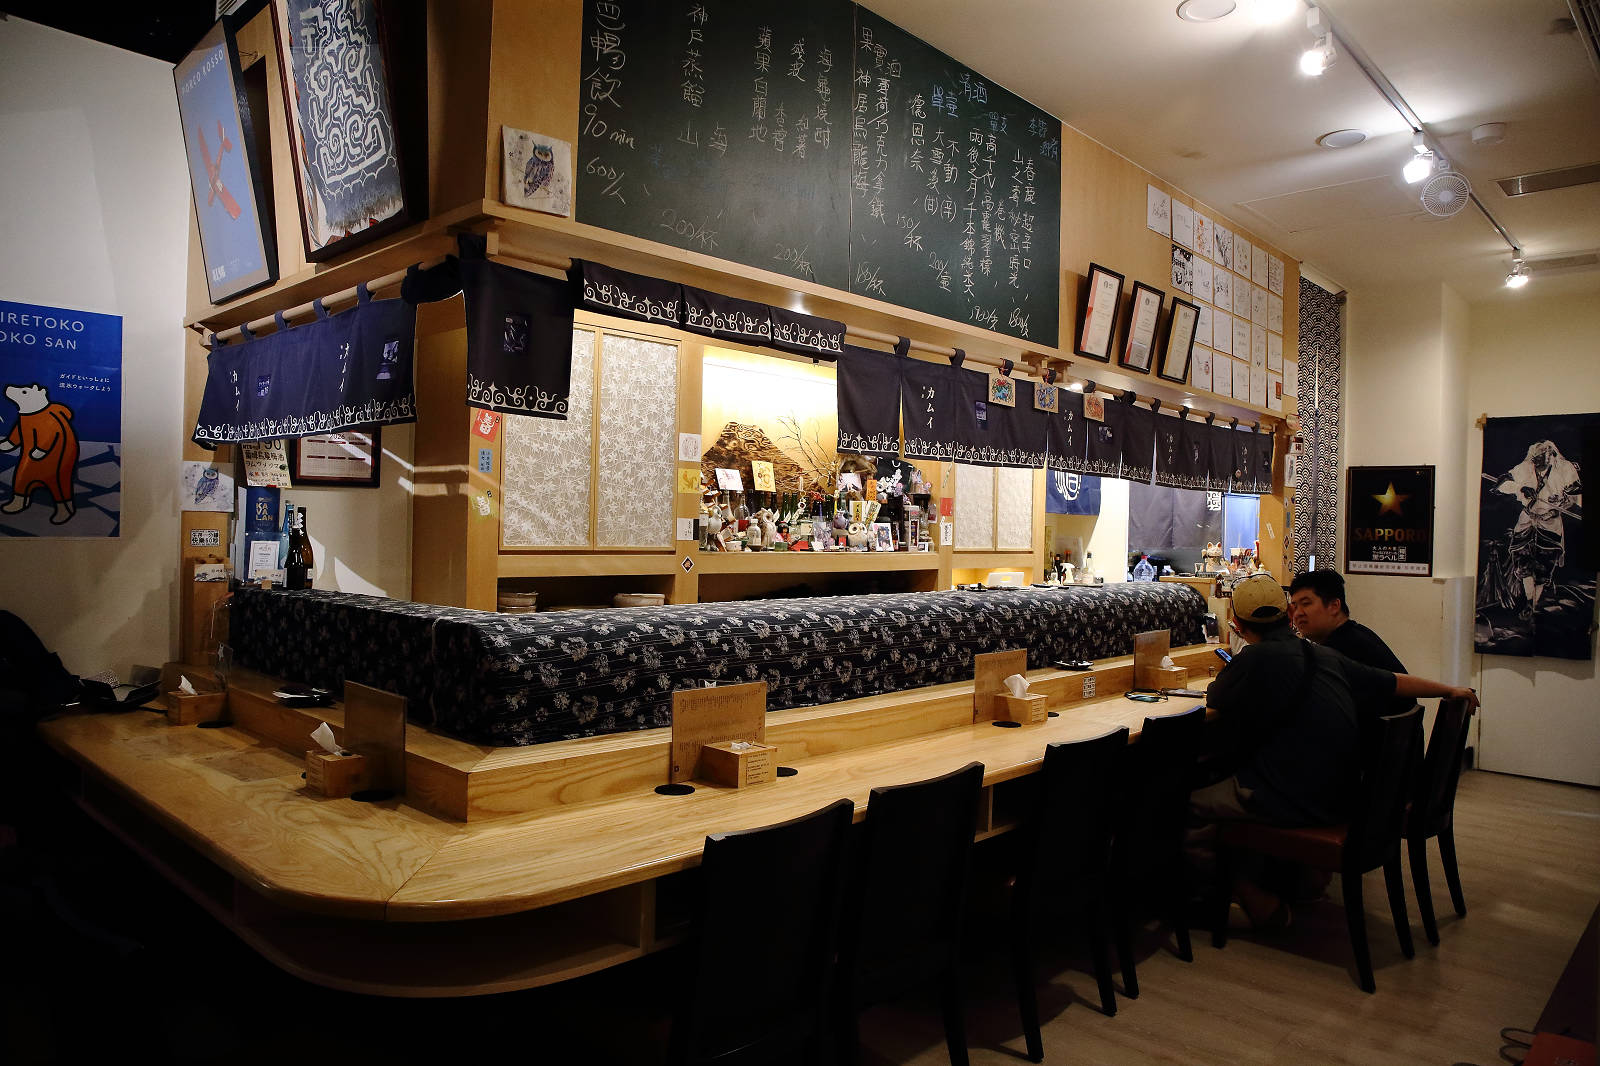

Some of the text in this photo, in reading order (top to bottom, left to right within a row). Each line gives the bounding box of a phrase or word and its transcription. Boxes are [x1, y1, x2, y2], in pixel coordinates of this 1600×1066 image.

[584, 103, 635, 150] 90 min
[45, 336, 76, 350] SAN
[926, 386, 935, 429] カムイ
